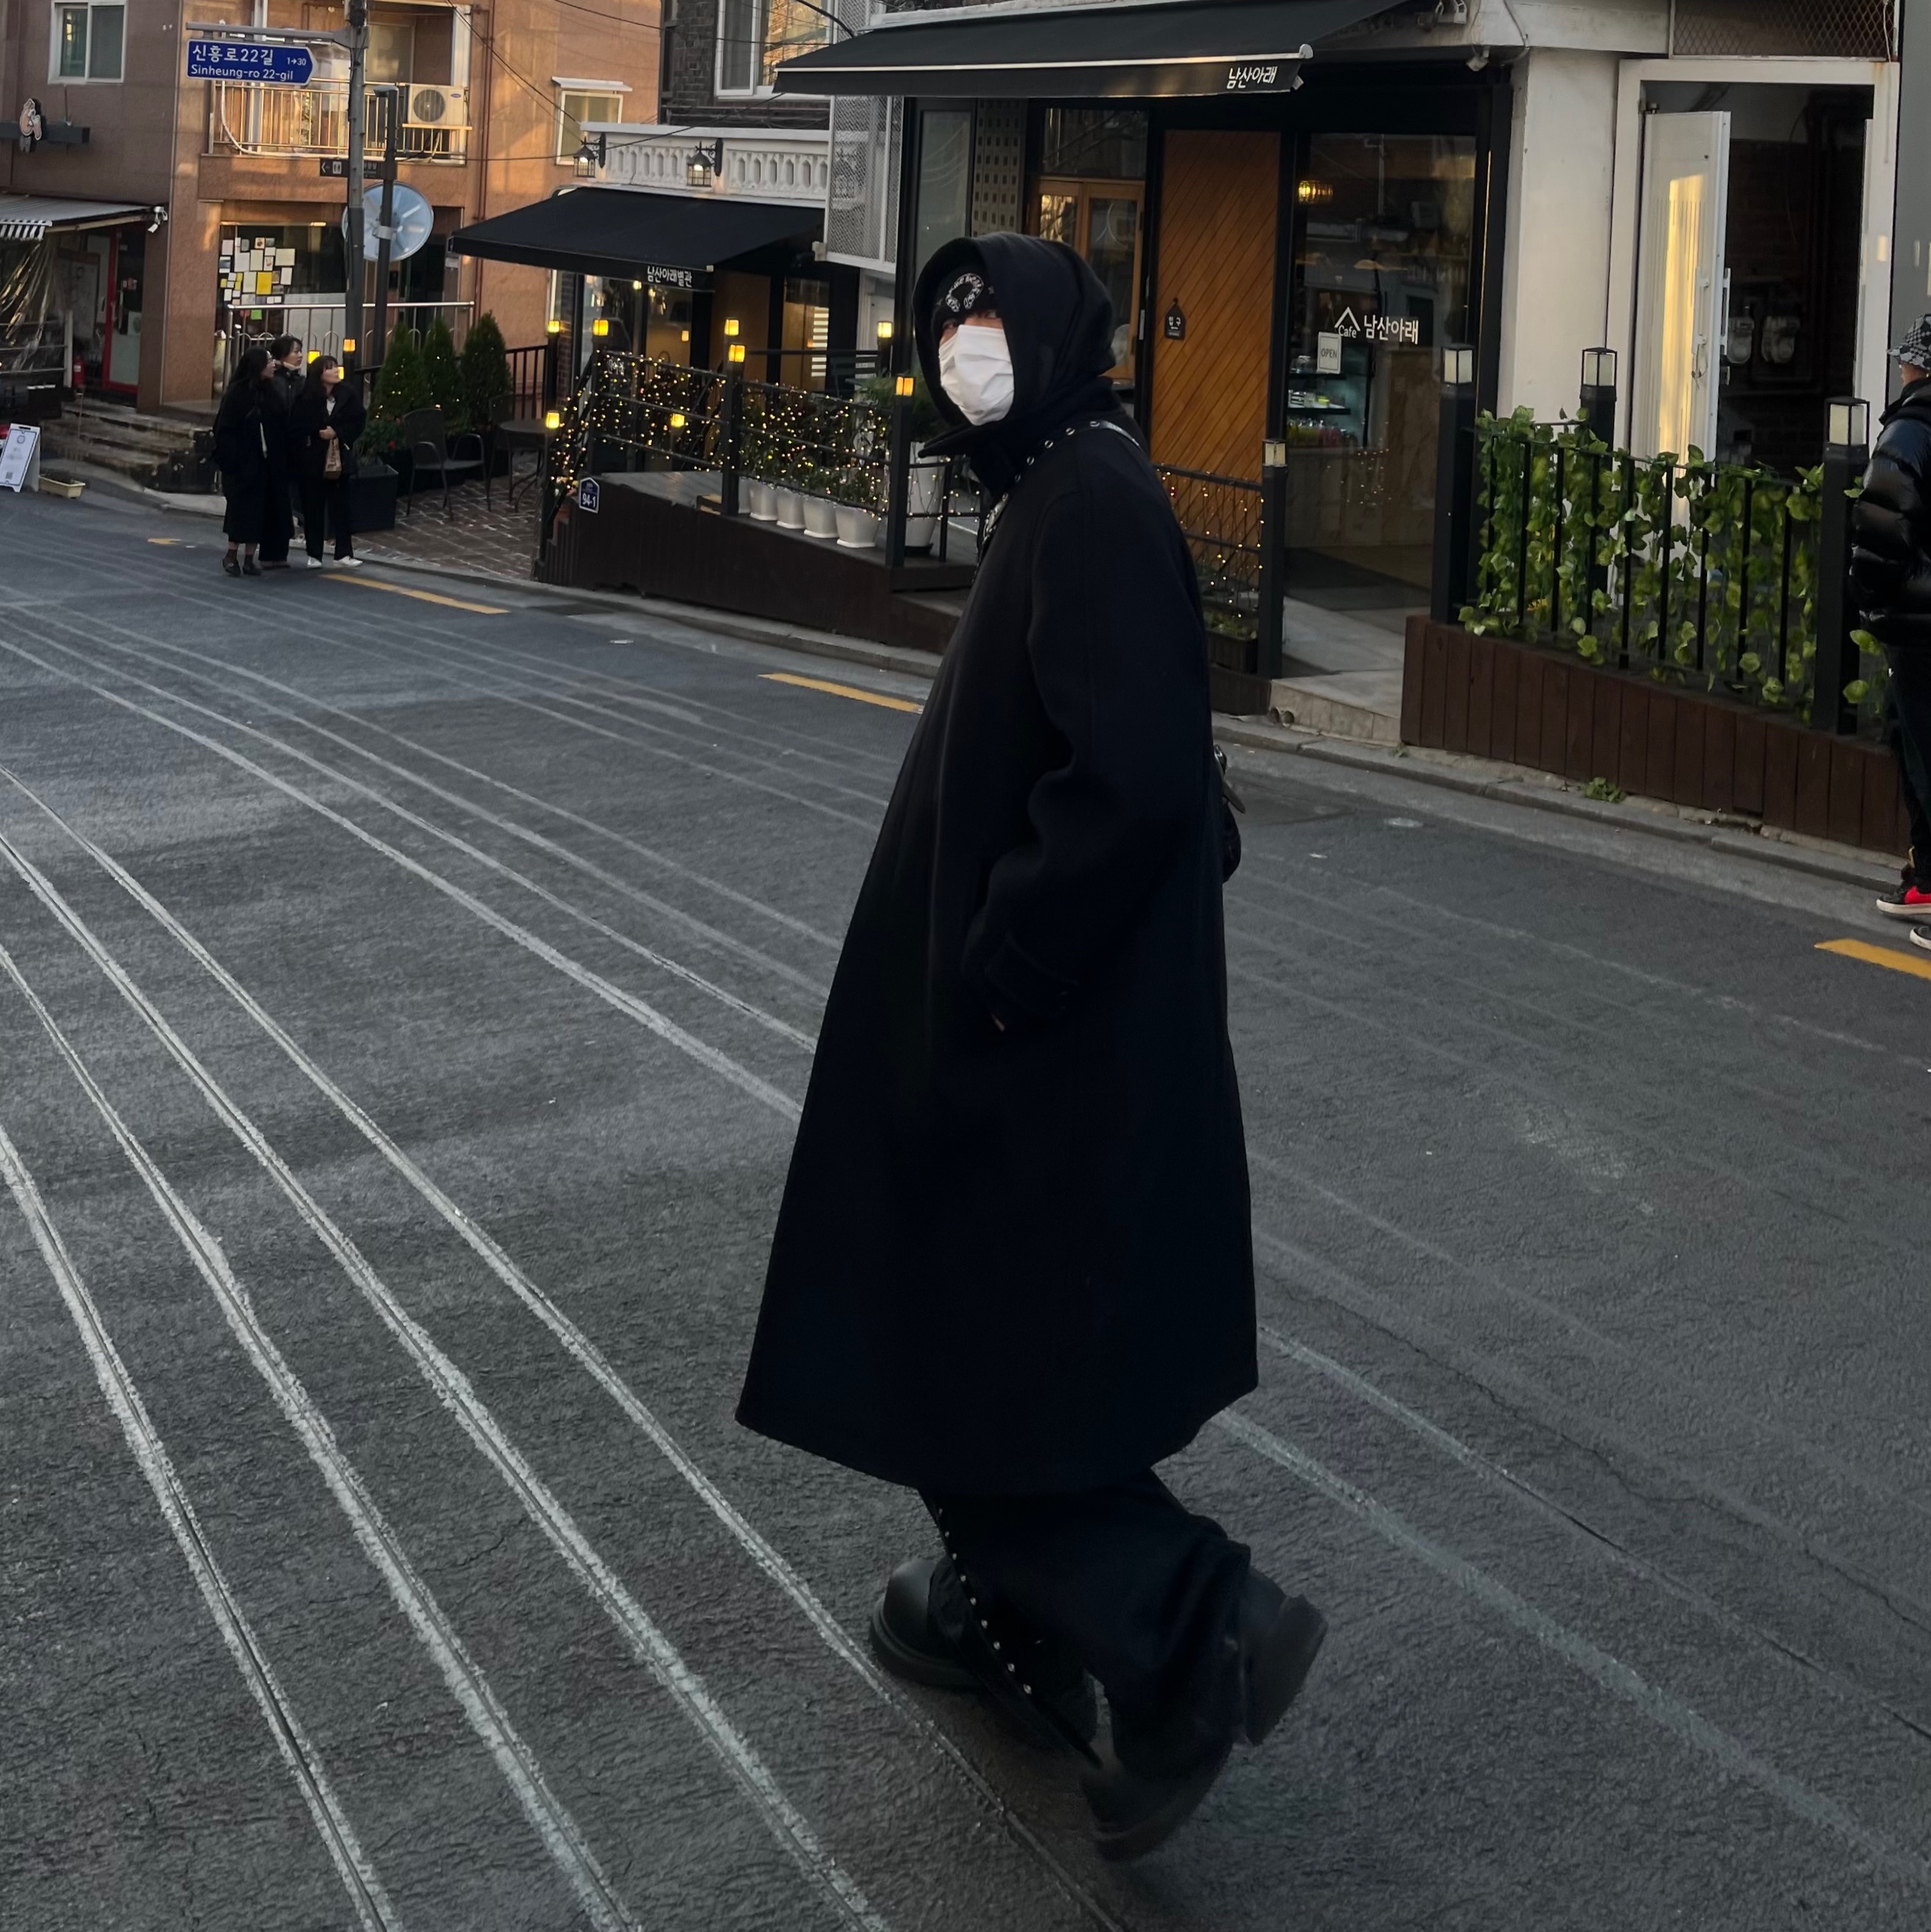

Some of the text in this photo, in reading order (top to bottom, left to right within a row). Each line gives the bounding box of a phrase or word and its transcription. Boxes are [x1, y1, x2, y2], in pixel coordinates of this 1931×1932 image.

[192, 44, 273, 66] 신흥로22길
[191, 64, 293, 82] Sinheung-ro 22-gil
[1226, 66, 1278, 89] 남산아래
[647, 265, 693, 288] 남산아래별관
[1338, 315, 1419, 345] Cafe 남산아래
[1321, 348, 1338, 359] OPEN
[582, 492, 596, 508] 94-1
